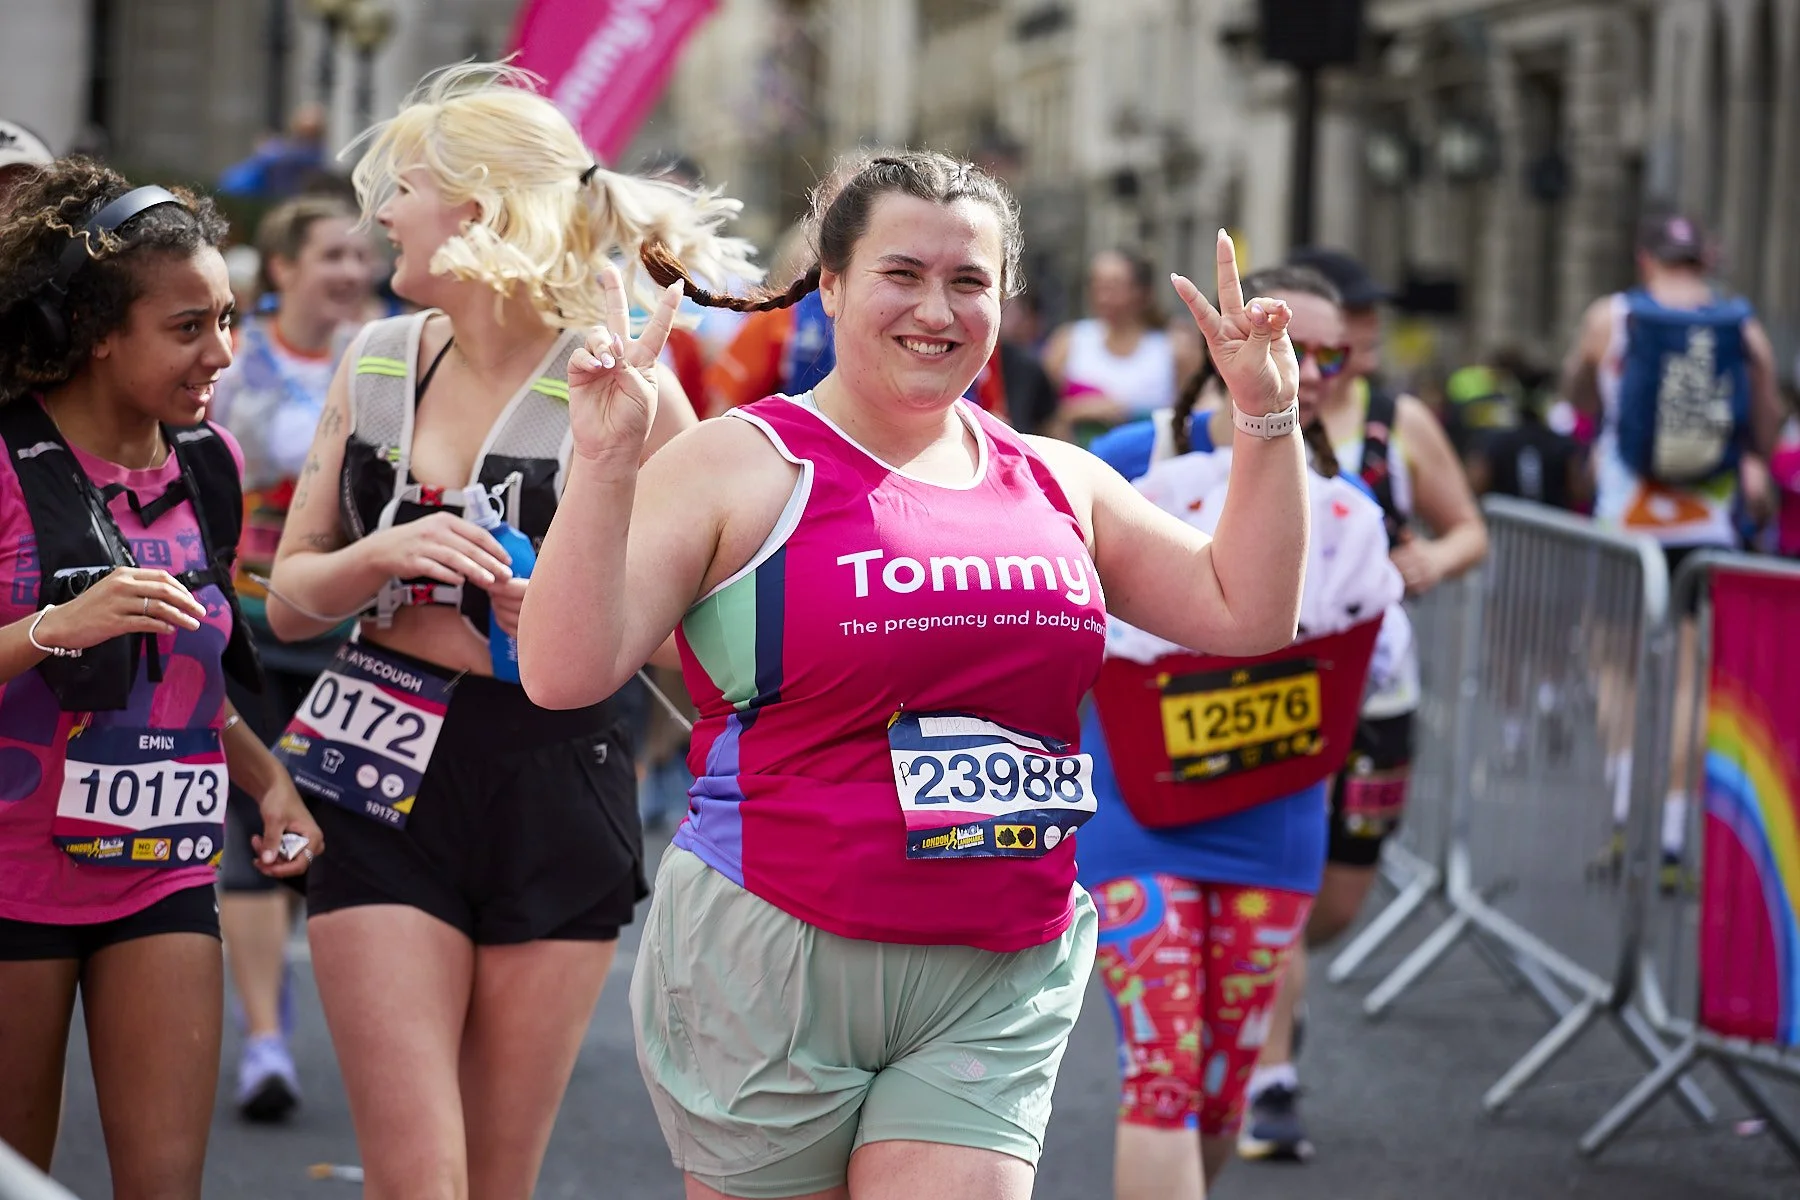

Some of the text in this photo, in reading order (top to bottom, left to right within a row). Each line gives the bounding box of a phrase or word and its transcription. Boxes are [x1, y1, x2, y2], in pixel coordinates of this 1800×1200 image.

[840, 619, 877, 635] The
[884, 612, 987, 634] pregnancy
[994, 610, 1030, 626] and
[1036, 610, 1080, 631] baby
[347, 650, 423, 693] AYSCOUGH
[1178, 685, 1311, 742] 12576
[139, 735, 174, 750] EMILY
[80, 769, 218, 816] 10173
[910, 752, 1083, 805] 23988
[921, 833, 949, 848] LONDON
